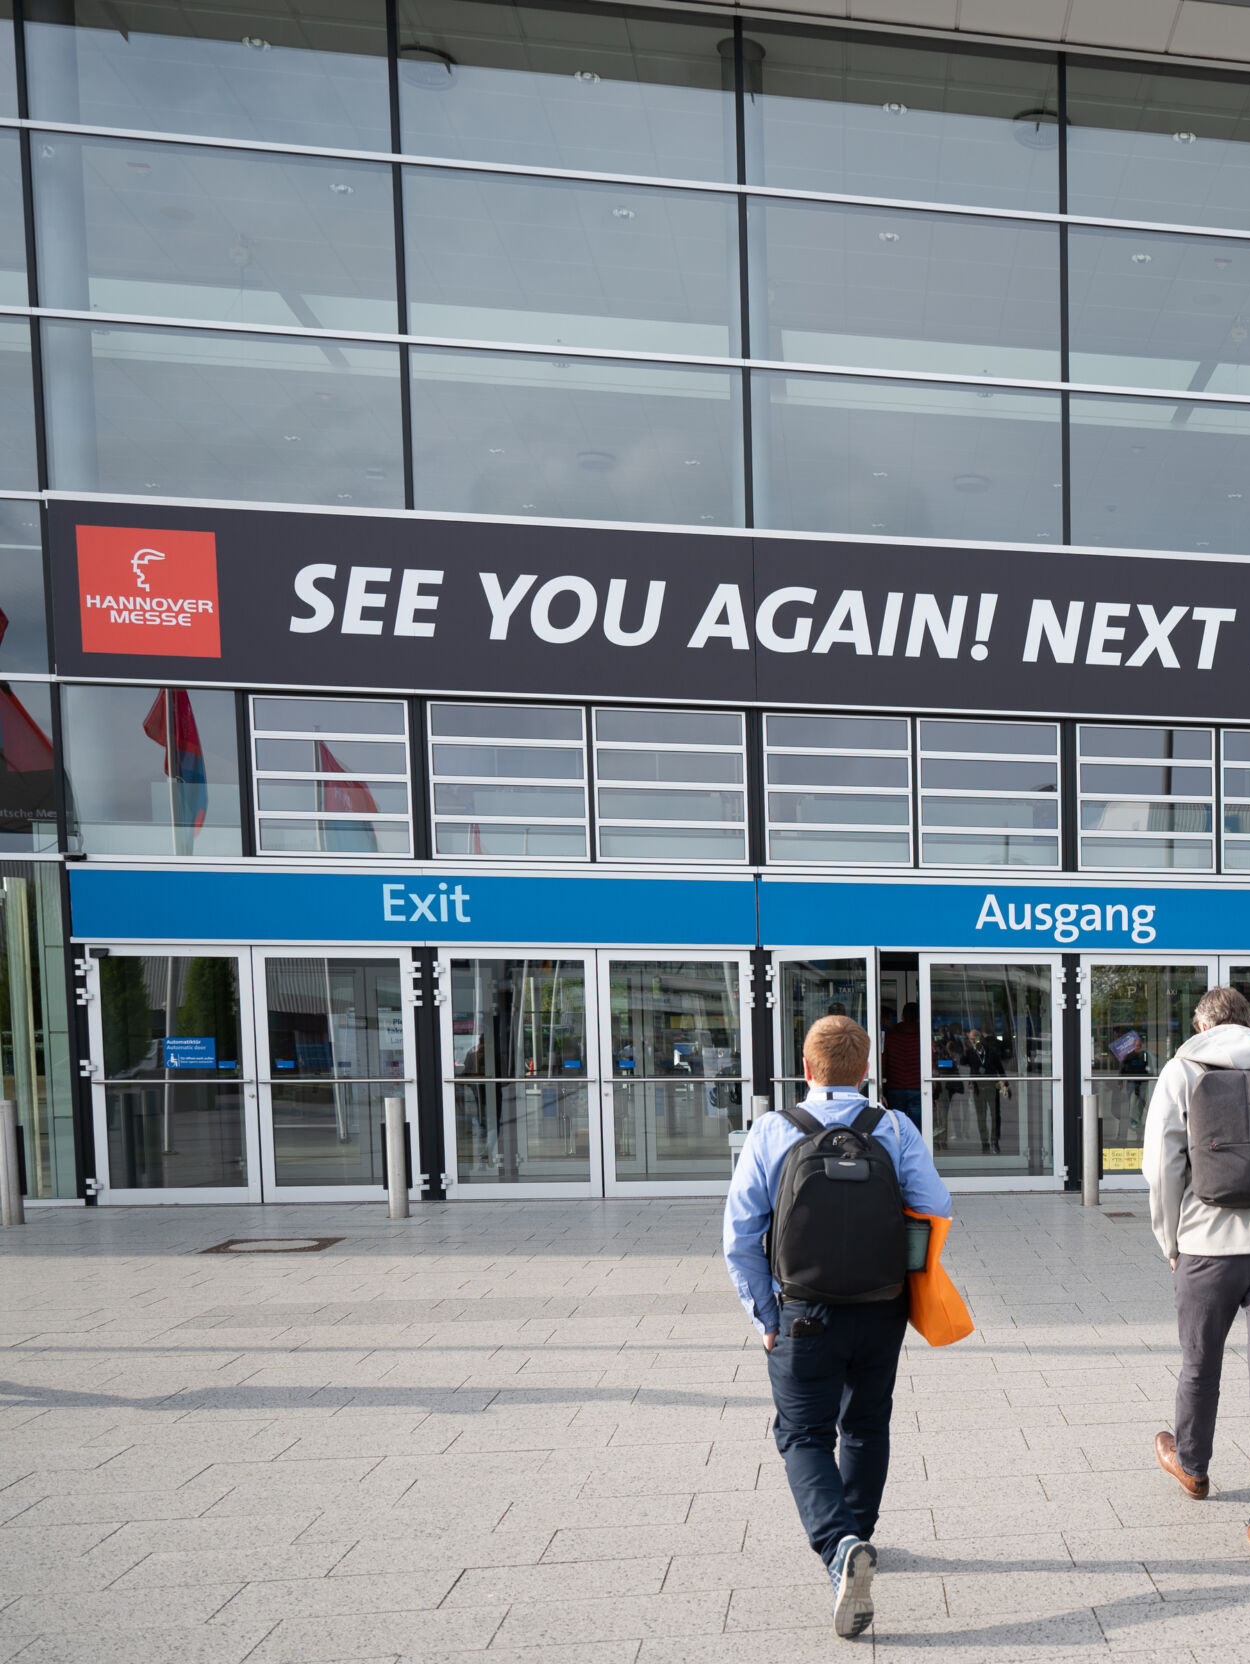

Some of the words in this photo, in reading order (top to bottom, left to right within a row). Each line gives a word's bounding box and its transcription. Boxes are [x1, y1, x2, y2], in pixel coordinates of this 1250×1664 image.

[86, 594, 214, 614] HANNOVER
[110, 610, 192, 627] MESSE
[290, 563, 445, 638] SEE
[478, 573, 667, 647] YOU
[687, 584, 999, 661] AGAIN!
[1022, 599, 1237, 670] NEXT
[382, 882, 471, 923] Exit
[975, 893, 1157, 945] Ausgang
